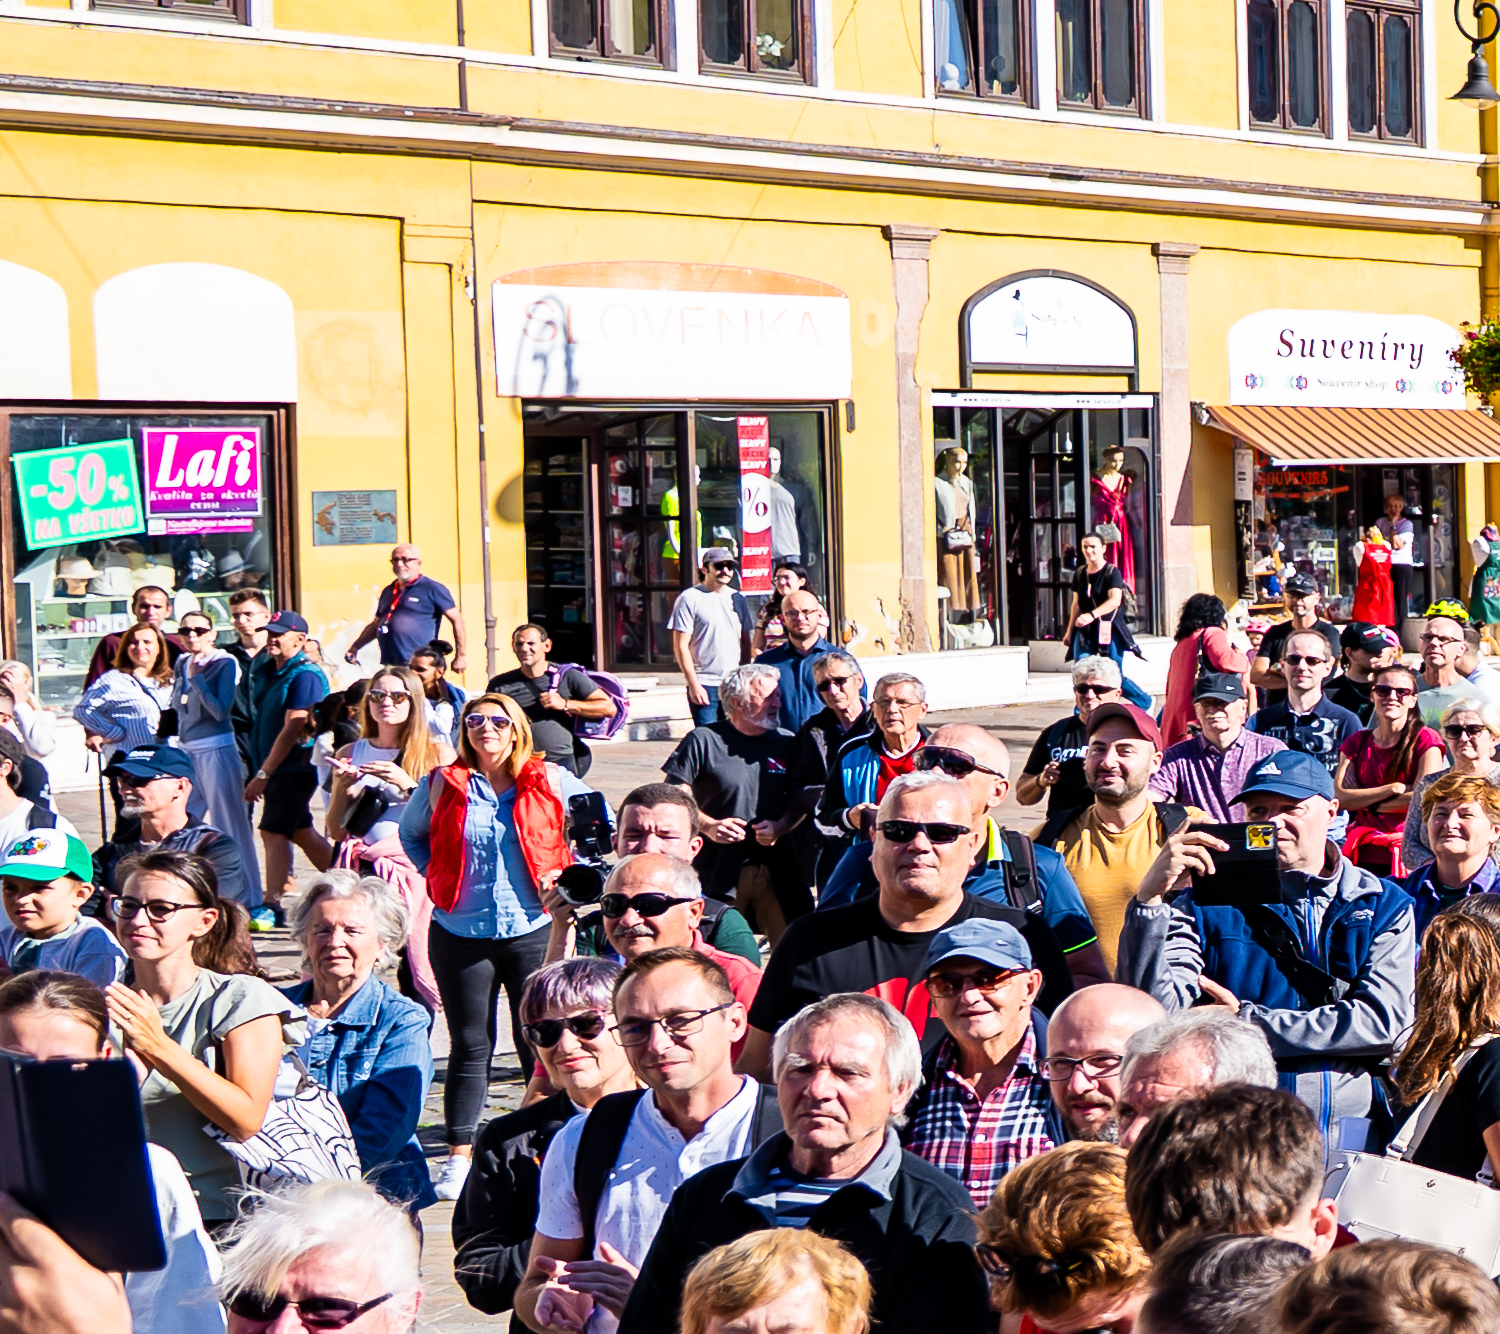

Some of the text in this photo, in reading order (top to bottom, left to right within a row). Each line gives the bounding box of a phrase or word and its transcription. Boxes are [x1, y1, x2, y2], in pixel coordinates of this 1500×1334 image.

[523, 299, 823, 348] SLOVENKA
[1277, 328, 1423, 369] Suveníry
[1318, 378, 1388, 390] Souvenir shop
[35, 505, 134, 540] NA VŠETKO
